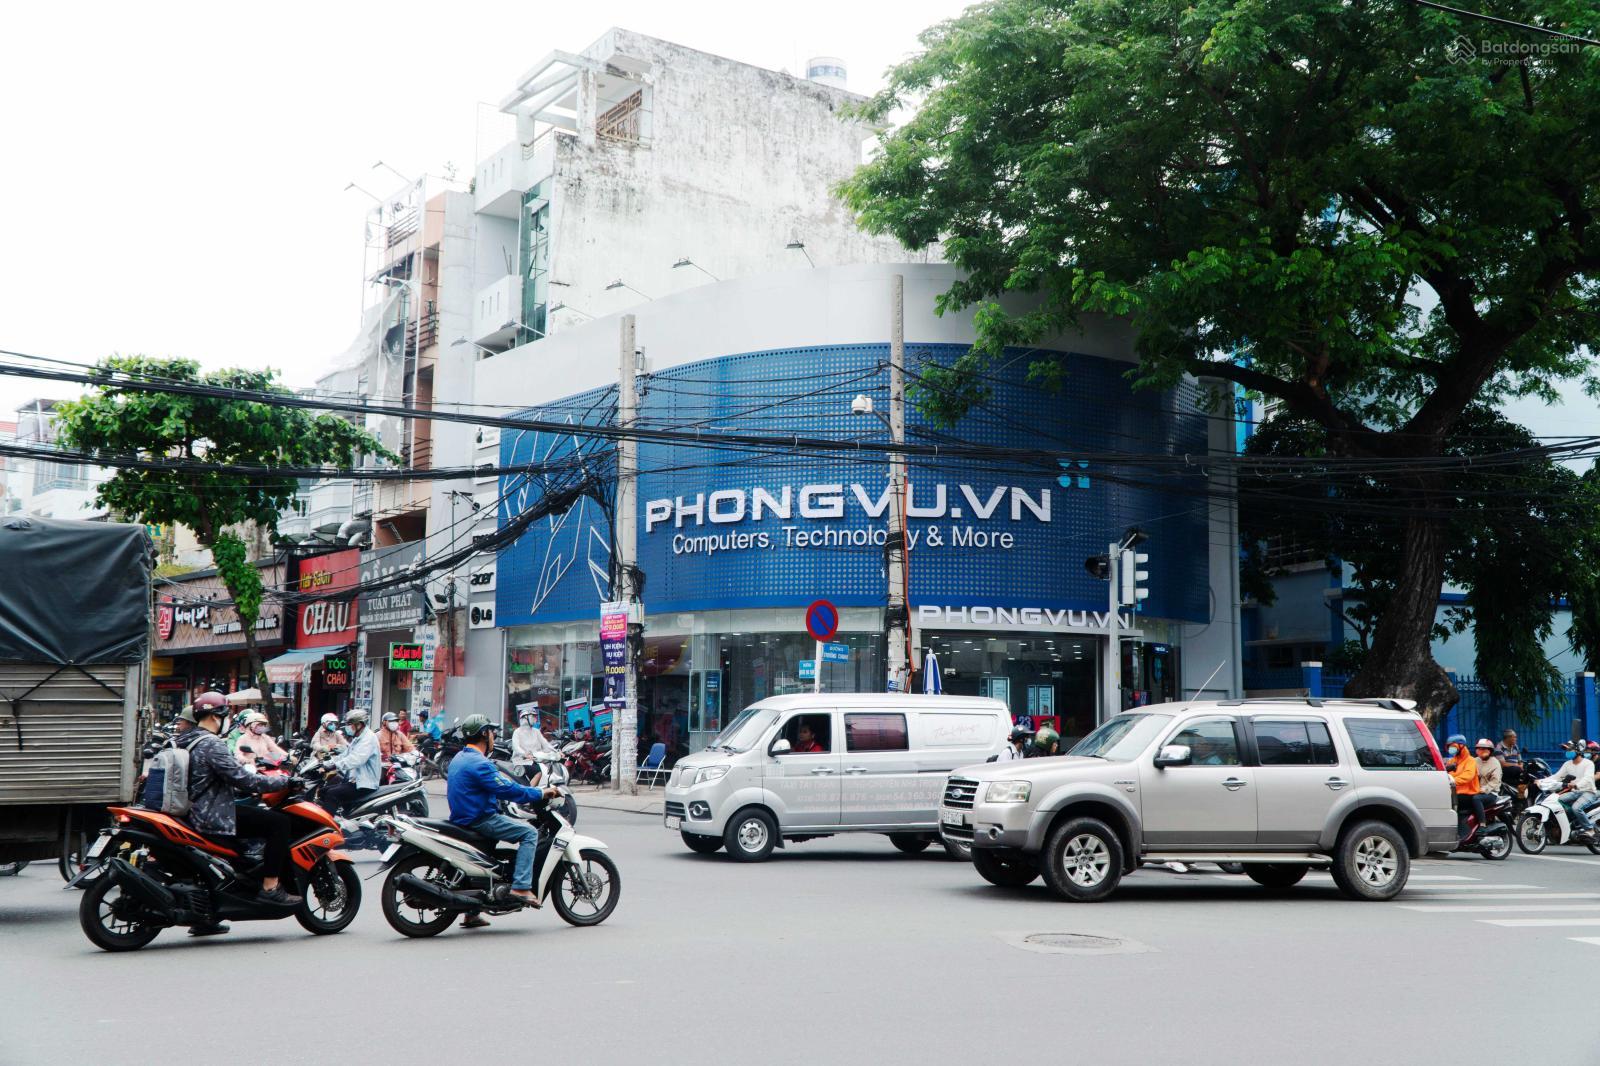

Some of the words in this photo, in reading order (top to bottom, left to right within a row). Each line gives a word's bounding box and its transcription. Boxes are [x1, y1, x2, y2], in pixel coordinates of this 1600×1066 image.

[645, 484, 1052, 533] PHONGVU.VN
[672, 527, 775, 554] Computers,
[782, 525, 922, 550] Technoloy
[926, 526, 944, 547] &
[952, 526, 1014, 548] More
[470, 571, 495, 586] acer
[481, 608, 493, 621] LG
[918, 605, 1129, 629] PHONGVU.VN
[327, 657, 346, 669] TÓC
